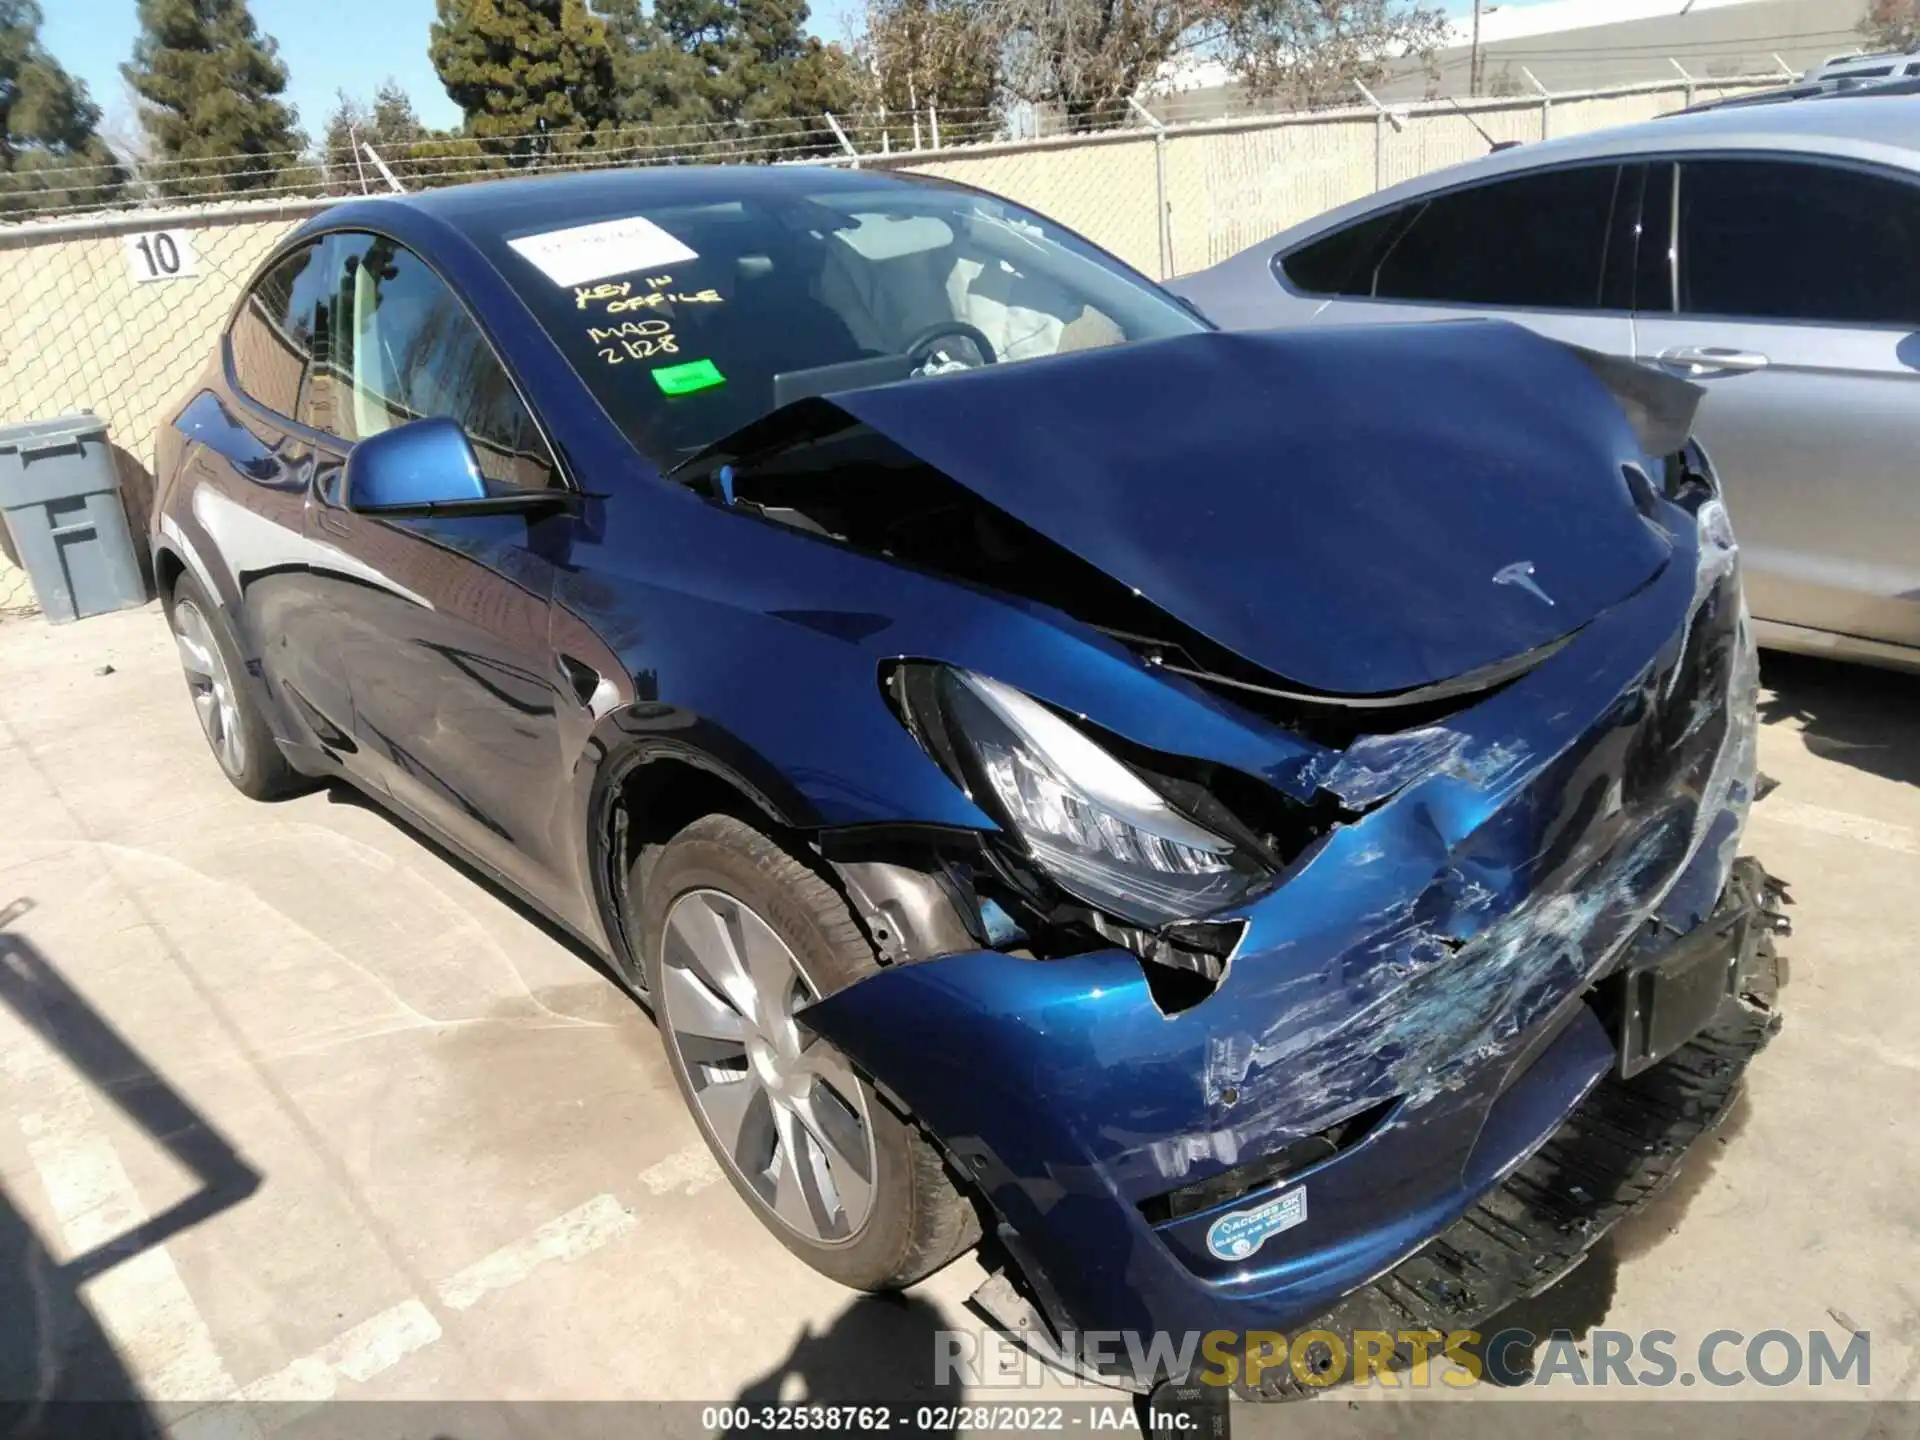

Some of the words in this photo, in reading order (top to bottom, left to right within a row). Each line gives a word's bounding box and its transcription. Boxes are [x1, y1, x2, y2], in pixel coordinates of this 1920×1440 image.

[136, 232, 180, 276] 10
[573, 280, 631, 309] KEY
[586, 319, 670, 345] MAD
